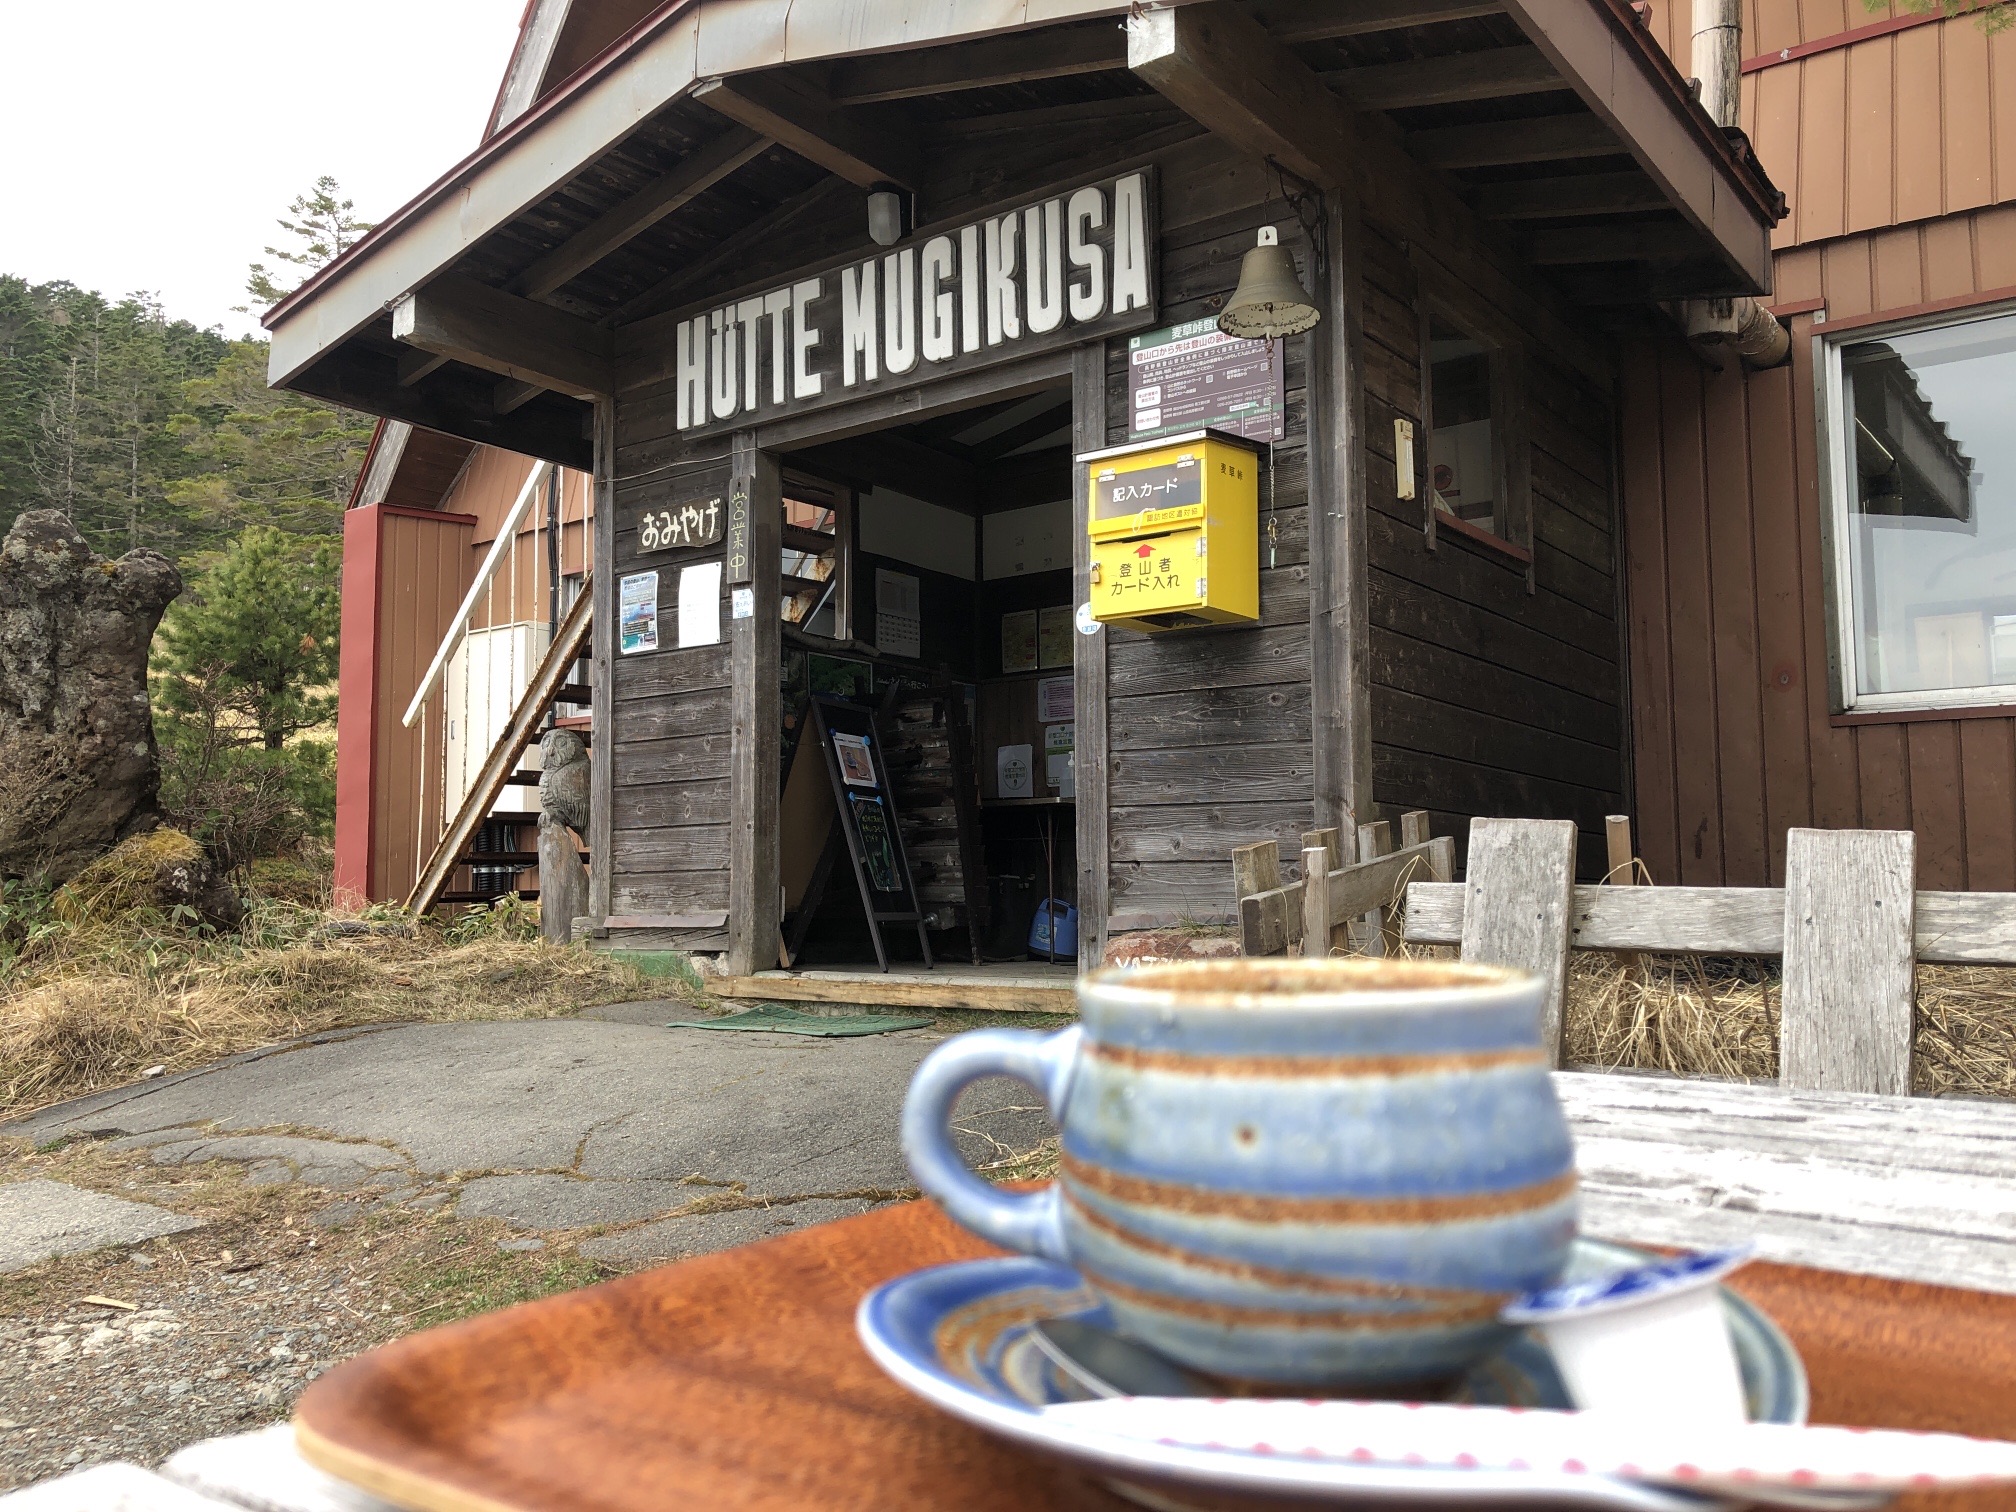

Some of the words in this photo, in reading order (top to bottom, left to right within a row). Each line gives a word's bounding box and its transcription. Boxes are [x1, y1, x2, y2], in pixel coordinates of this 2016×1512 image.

[676, 278, 822, 431] HÜTTE
[841, 173, 1151, 387] MUGIKUSA
[1112, 477, 1178, 503] 記入カード
[641, 497, 721, 549] おみやげ
[730, 491, 748, 579] 営業中
[1111, 574, 1180, 597] カード入れ
[1119, 557, 1172, 579] 登山者
